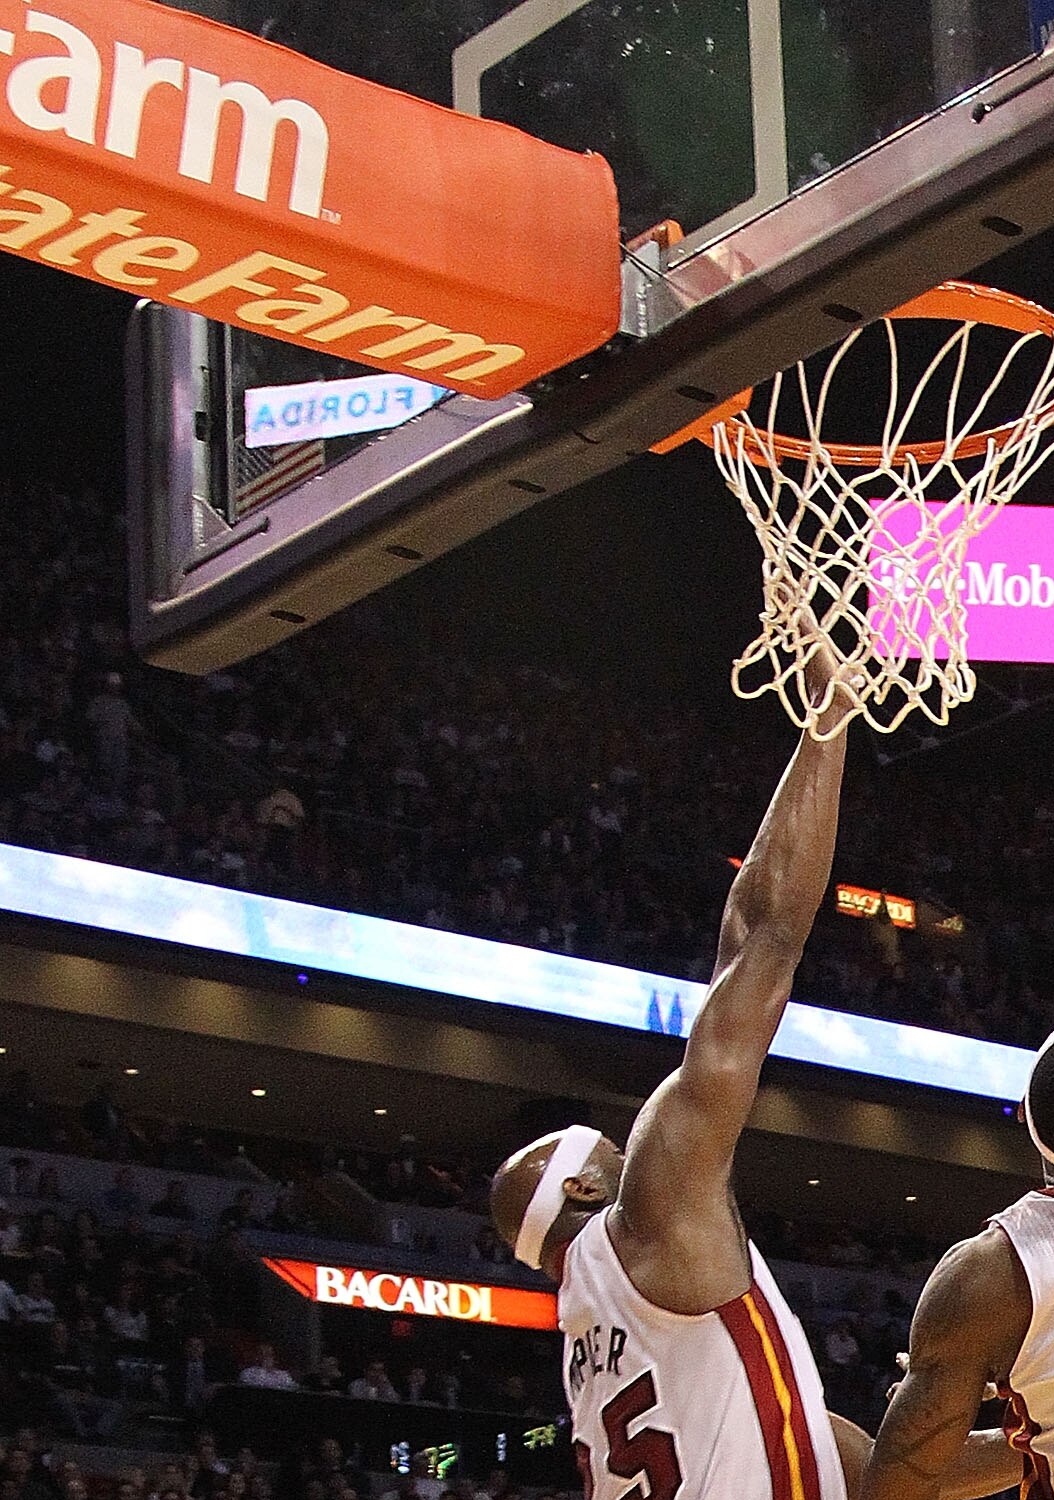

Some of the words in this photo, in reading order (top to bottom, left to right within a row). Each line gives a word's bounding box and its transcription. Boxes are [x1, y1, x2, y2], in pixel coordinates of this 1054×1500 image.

[0, 0, 330, 219] arm
[168, 250, 526, 382] Farm
[315, 1265, 496, 1322] BACARDI
